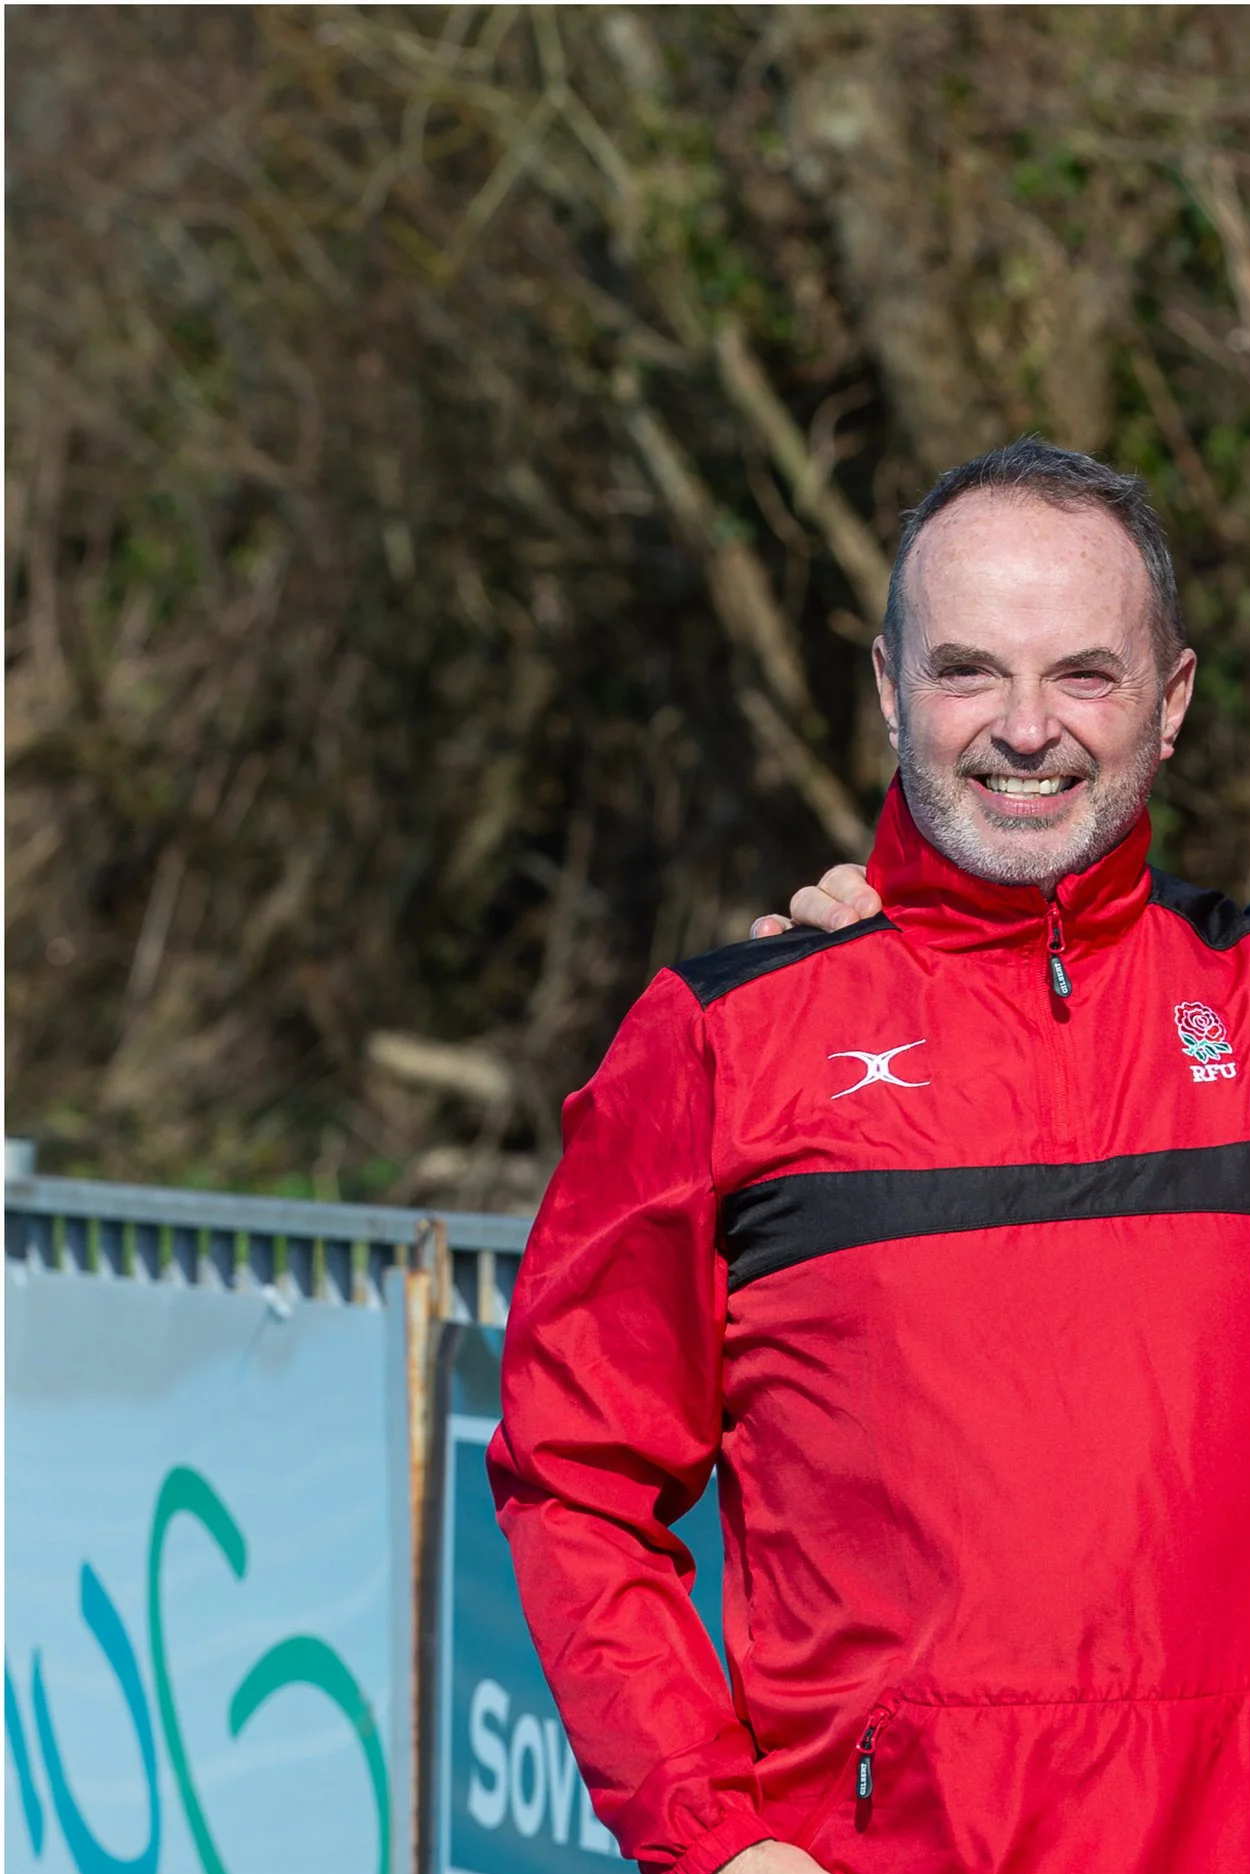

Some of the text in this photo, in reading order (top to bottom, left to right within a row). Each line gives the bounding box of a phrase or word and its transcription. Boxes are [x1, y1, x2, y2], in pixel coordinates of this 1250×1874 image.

[1054, 962, 1069, 995] GILBERT
[1189, 1062, 1237, 1083] RFU
[859, 1762, 868, 1796] GILBERT
